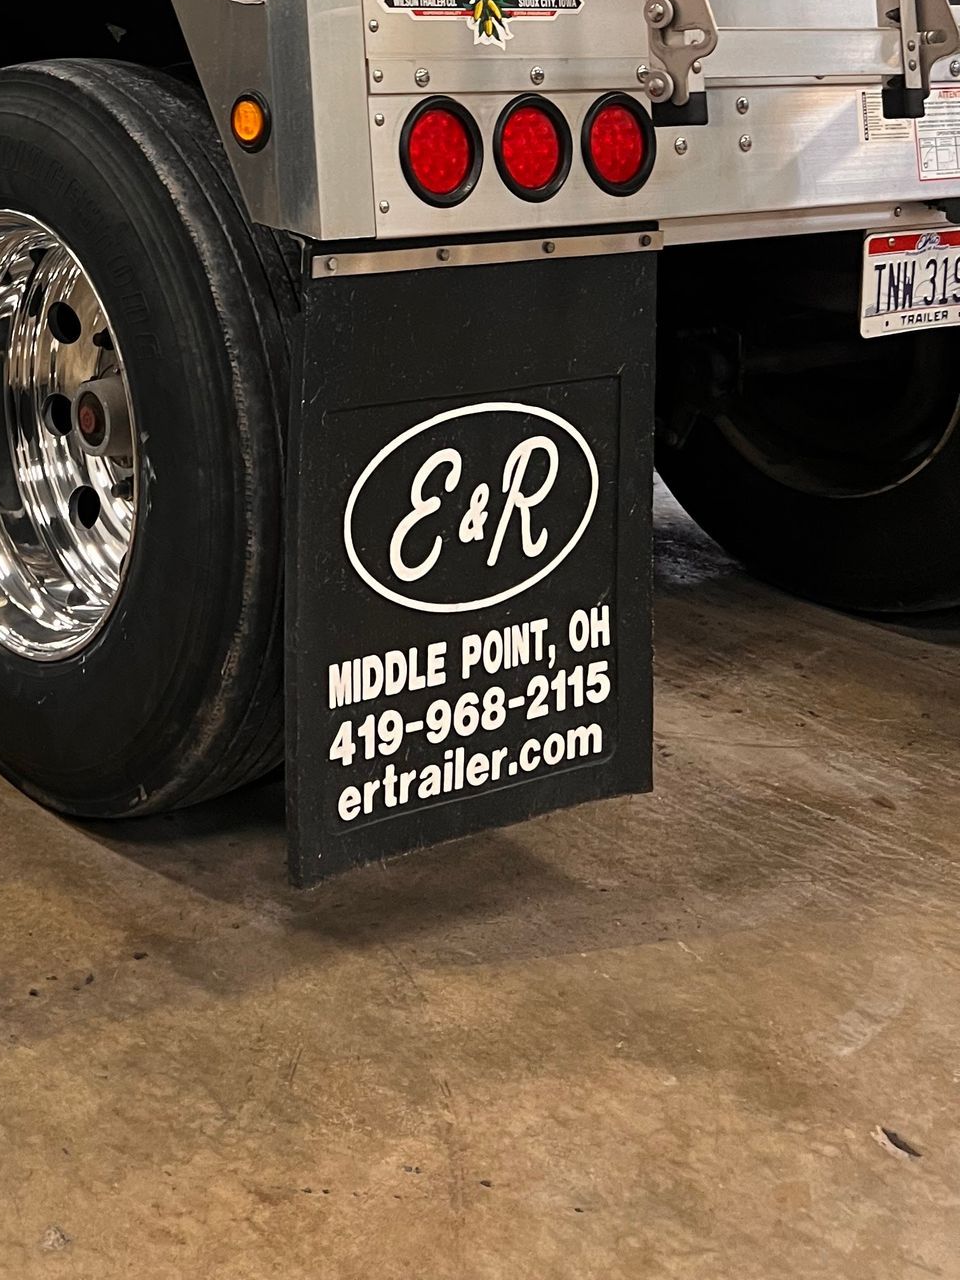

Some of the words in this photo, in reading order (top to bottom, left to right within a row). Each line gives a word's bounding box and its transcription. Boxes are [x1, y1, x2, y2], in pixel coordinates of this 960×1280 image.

[874, 260, 916, 314] TNW
[900, 310, 949, 325] TRAILER
[328, 641, 447, 710] MIDDLE
[461, 617, 556, 680] POINT,
[568, 605, 610, 653] OH
[328, 660, 611, 767] 419-968-2115
[337, 722, 603, 822] ertrailer.com
